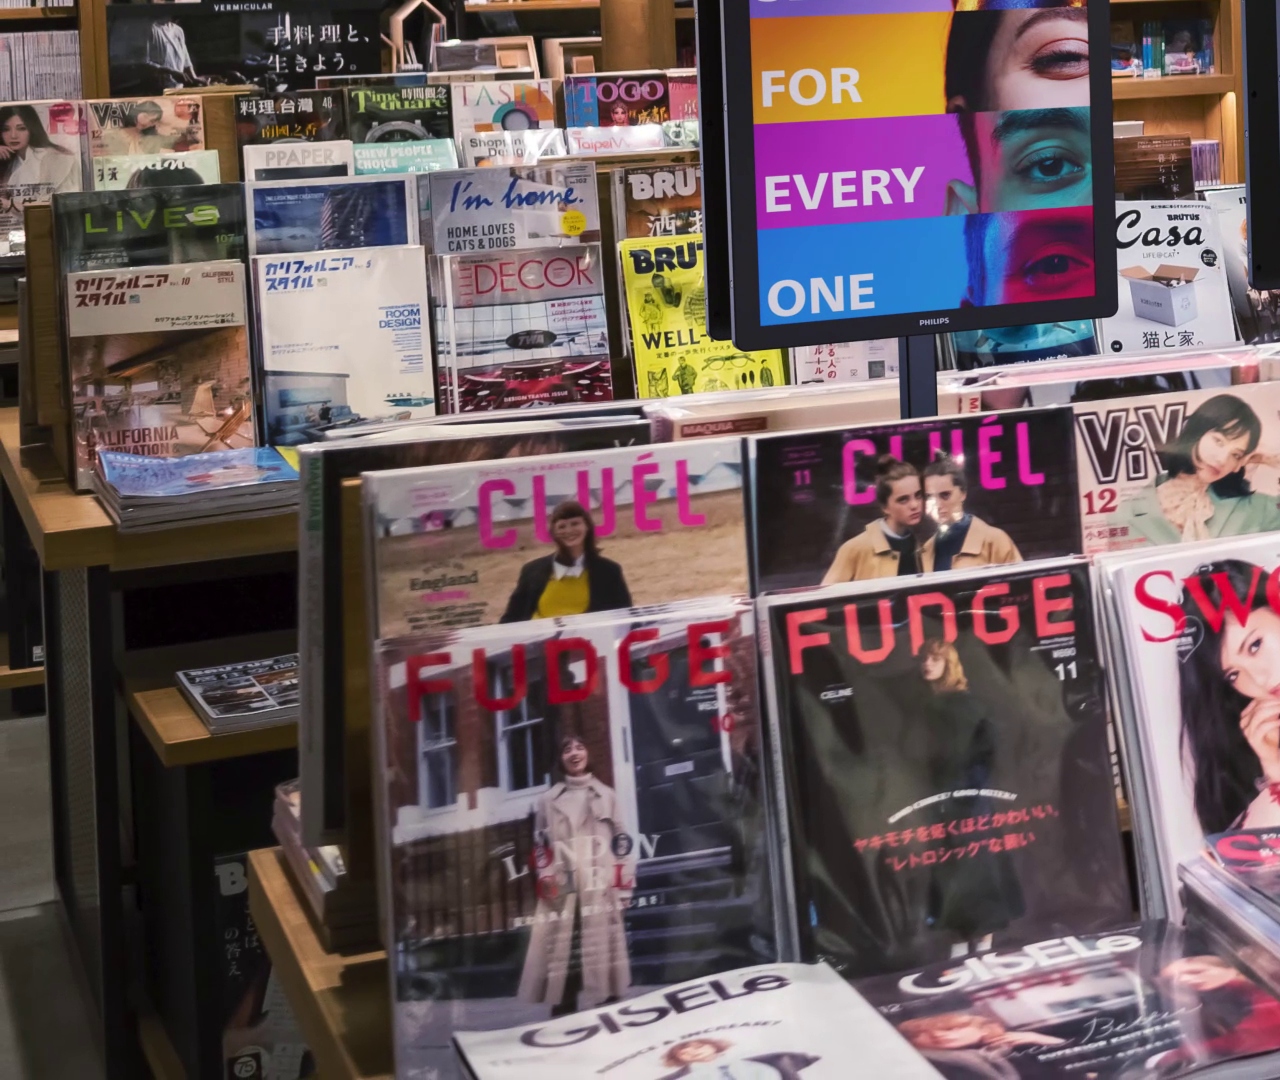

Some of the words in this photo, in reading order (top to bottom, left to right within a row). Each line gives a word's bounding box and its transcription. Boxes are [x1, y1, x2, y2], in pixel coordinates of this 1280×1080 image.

[213, 2, 273, 12] VERMICULAR
[268, 53, 357, 73] 生きよう。
[454, 83, 549, 106] TASTE
[761, 67, 862, 108] FOR
[265, 149, 335, 167] PPAPER
[450, 180, 493, 212] I'm
[502, 177, 584, 209] home.
[765, 166, 925, 213] EVERY
[447, 225, 480, 239] HOME
[482, 223, 515, 236] LOVES
[1115, 209, 1206, 249] Casa
[214, 234, 234, 244] 107
[448, 238, 476, 251] CATS
[478, 237, 486, 249] &
[488, 236, 516, 248] DOGS
[202, 271, 234, 279] CALIFORNIA
[265, 257, 354, 276] カリフォルニア
[473, 256, 594, 294] DECOR
[75, 274, 169, 292] カリフォルニア
[181, 277, 190, 286] 10
[266, 276, 314, 291] スタイル
[75, 292, 127, 308] スタイル
[767, 273, 875, 318] ONE
[385, 308, 420, 318] ROOM
[919, 317, 949, 326] PHILIPS
[379, 318, 421, 328] DESIGN
[518, 334, 544, 347] TWA
[504, 394, 526, 402] DESIGN
[527, 392, 550, 400] TRAVEL
[551, 390, 568, 398] ISSUE
[86, 427, 179, 448] CALIFORNIA
[1075, 401, 1189, 485] ViV
[477, 452, 706, 549] CLUÉL
[1083, 488, 1118, 516] 12
[409, 570, 478, 593] England
[786, 573, 1075, 675] FUDGE
[406, 620, 734, 721] FUDGE
[1054, 661, 1078, 680] 11
